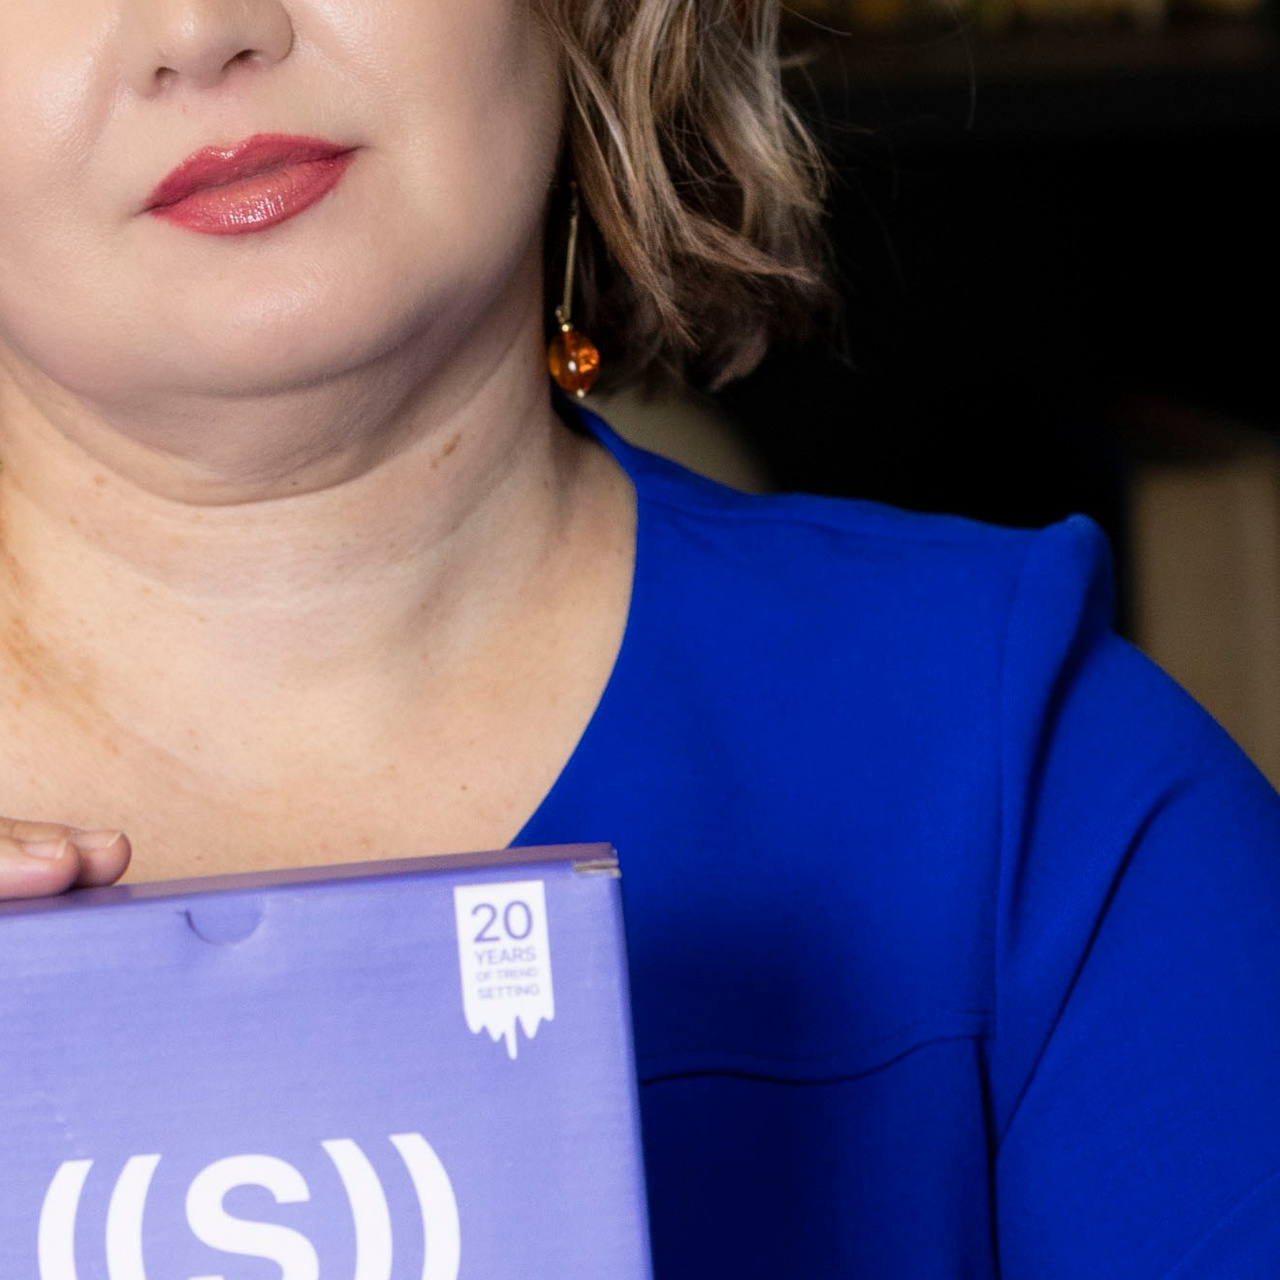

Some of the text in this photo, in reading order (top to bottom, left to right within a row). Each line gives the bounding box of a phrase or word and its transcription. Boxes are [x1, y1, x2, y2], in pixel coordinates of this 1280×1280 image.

[471, 900, 533, 943] 20
[474, 946, 537, 966] YEARS
[477, 984, 541, 1001] SETTING
